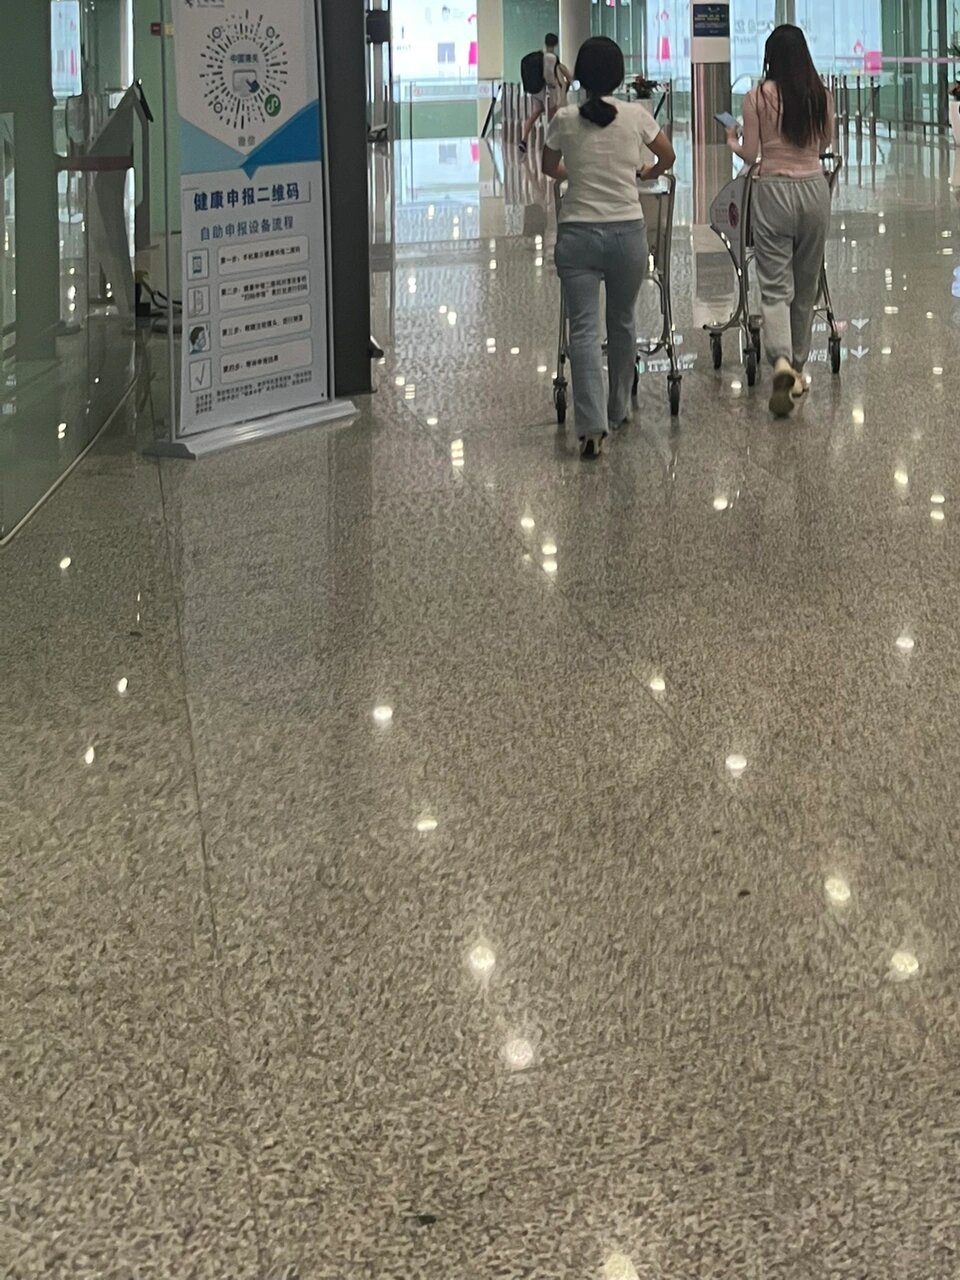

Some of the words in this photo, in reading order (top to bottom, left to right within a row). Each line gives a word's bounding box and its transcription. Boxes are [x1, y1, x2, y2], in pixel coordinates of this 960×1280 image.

[194, 182, 299, 211] 健康申报二维码
[200, 216, 294, 241] 自助申报设备流程
